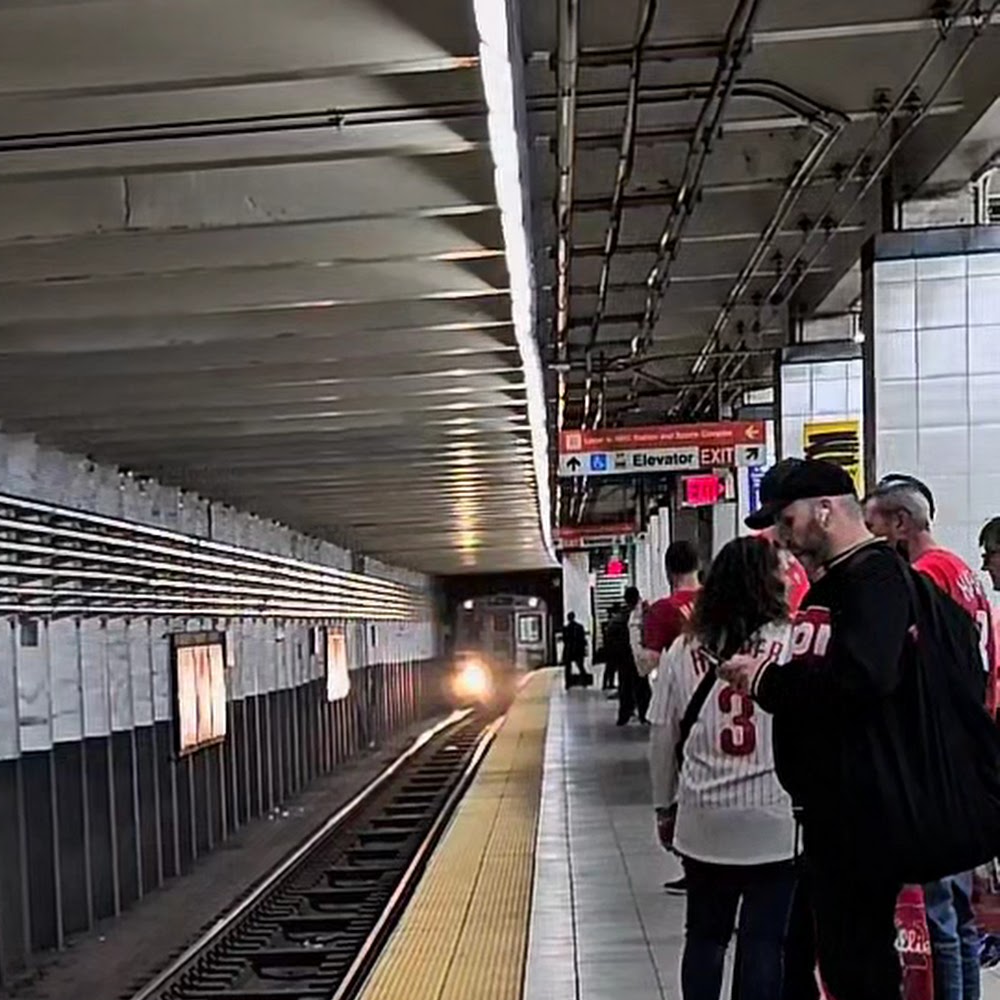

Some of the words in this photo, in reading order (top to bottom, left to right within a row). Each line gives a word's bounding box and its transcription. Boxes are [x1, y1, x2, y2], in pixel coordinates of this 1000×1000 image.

[633, 453, 694, 467] Elevator
[701, 447, 734, 465] EXIT
[718, 687, 756, 756] 3
